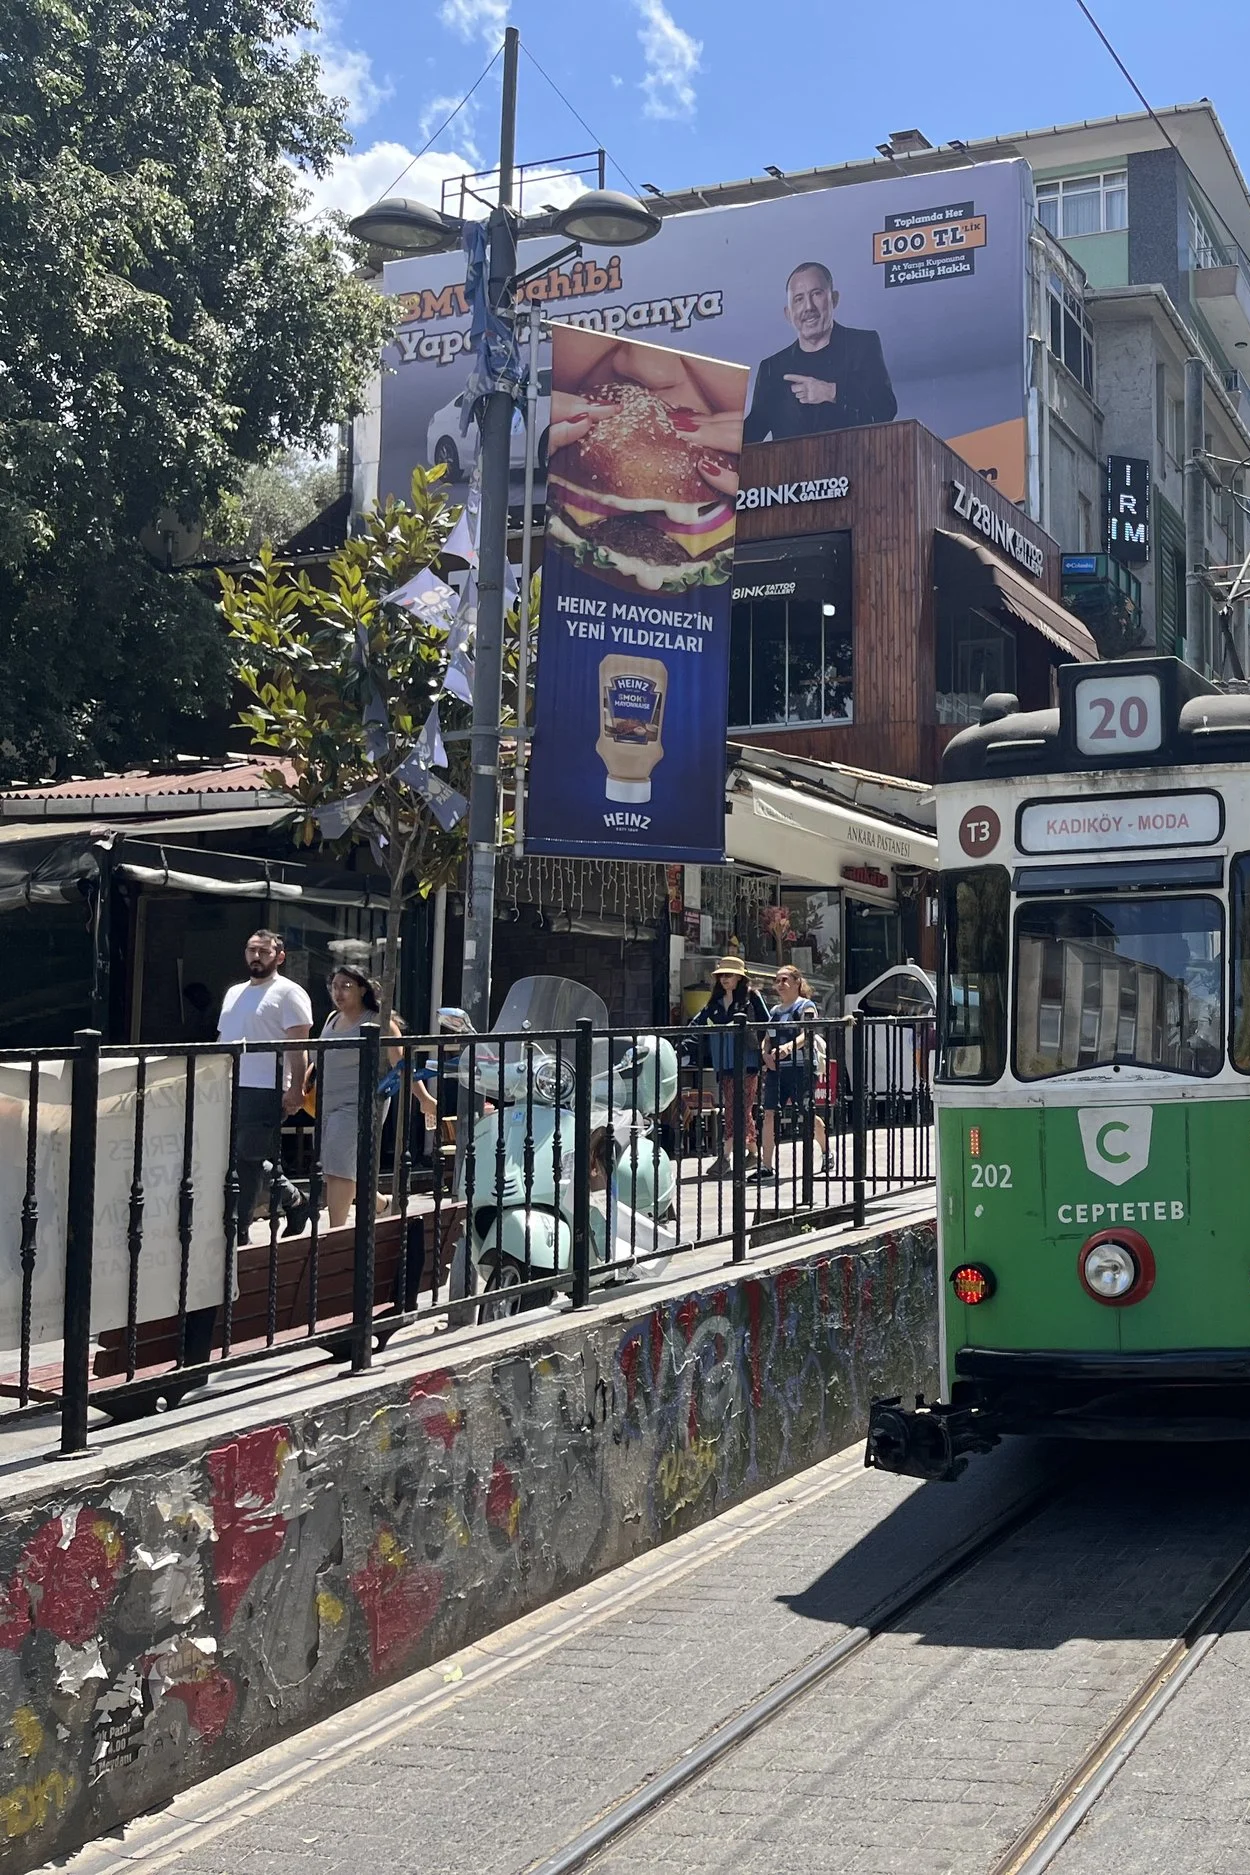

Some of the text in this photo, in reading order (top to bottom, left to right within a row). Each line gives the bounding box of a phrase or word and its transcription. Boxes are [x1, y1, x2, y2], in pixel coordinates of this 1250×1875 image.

[893, 208, 964, 228] Toplamda Her
[881, 232, 926, 257] 100
[931, 225, 966, 249] TL
[926, 255, 966, 267] Kuponuna
[512, 255, 623, 305] ahibi
[889, 263, 971, 284] 1 Çekiliş Hakkı
[400, 290, 723, 365] Yap mpanya
[800, 476, 849, 493] TATTOO
[800, 486, 849, 502] GALLERY
[1015, 531, 1044, 563] TATTOO
[1015, 547, 1044, 578] GALLERY
[764, 587, 796, 596] GALLERY
[765, 581, 796, 590] TATTOO
[557, 595, 714, 632] HEINZ MAYONEZ’İN
[566, 620, 703, 653] YENİ YILDIZLARI
[617, 679, 650, 692] HEINZ
[614, 700, 651, 710] MAYONNAISE
[618, 693, 648, 702] SMOKY
[1088, 696, 1148, 740] 20
[603, 812, 652, 830] HEINZ
[967, 820, 991, 843] T3
[1046, 813, 1123, 836] KADIKÖY
[1138, 813, 1190, 831] MODA
[847, 826, 876, 848] ANKARA
[1096, 1120, 1132, 1164] C
[971, 1163, 1013, 1188] 202
[1057, 1200, 1185, 1224] CEPTETEB
